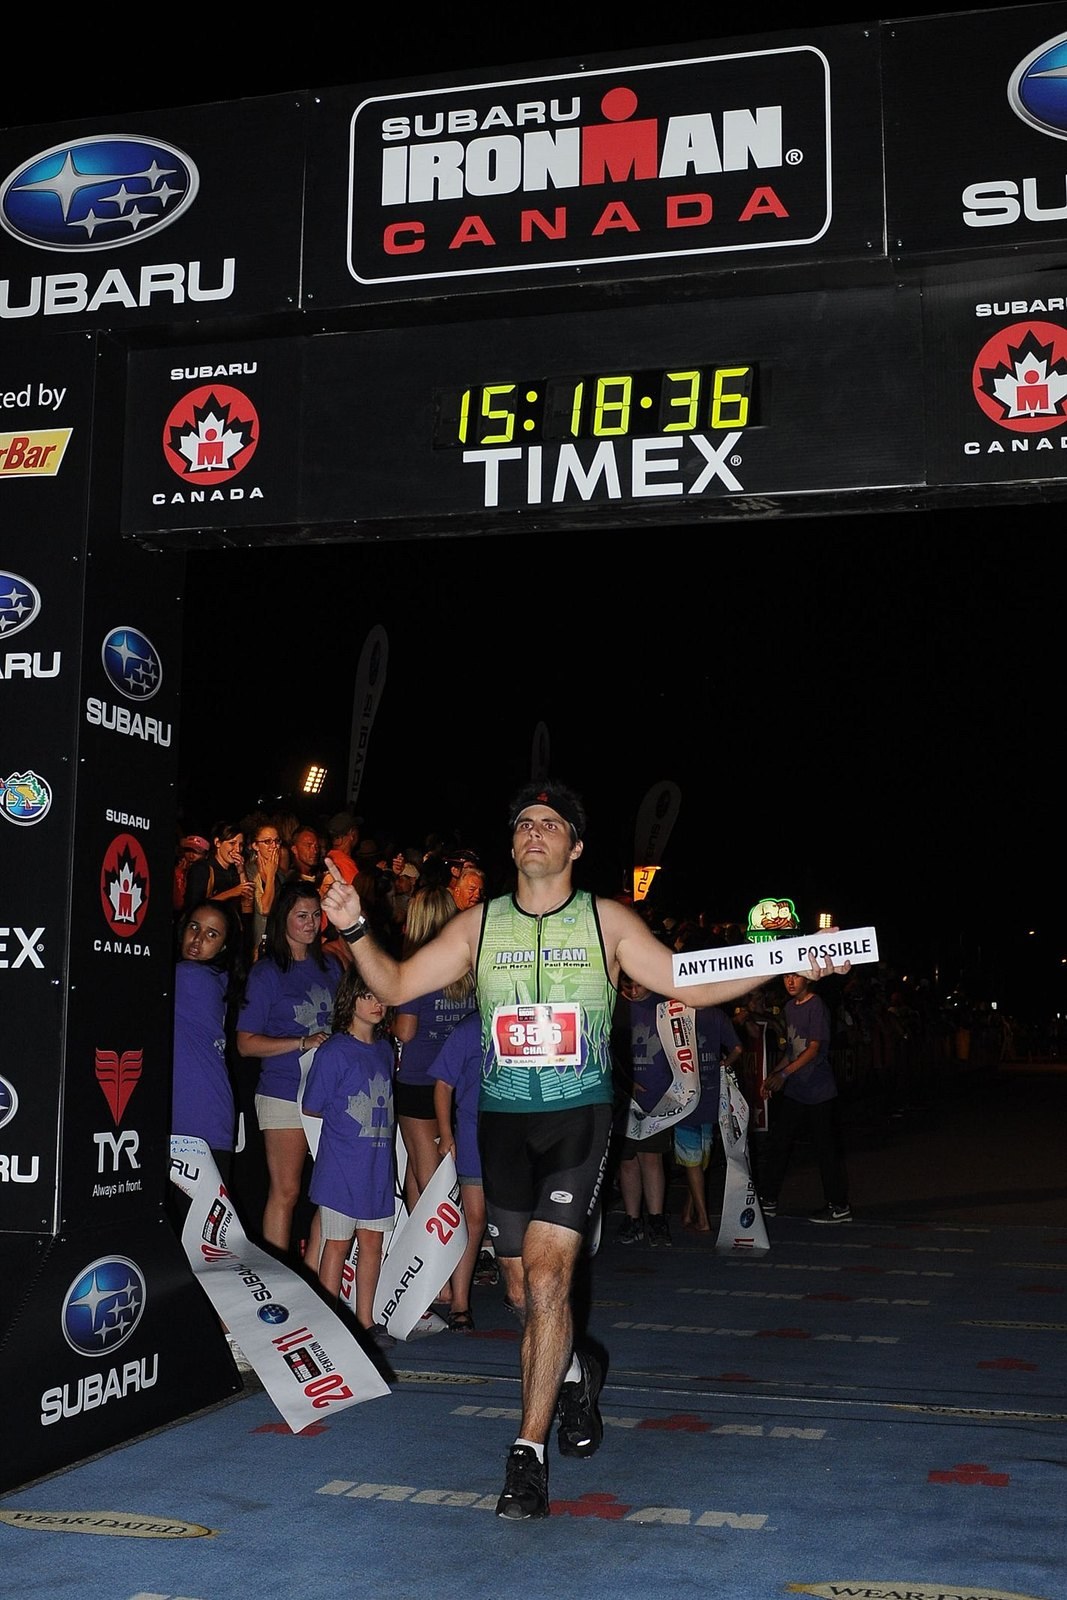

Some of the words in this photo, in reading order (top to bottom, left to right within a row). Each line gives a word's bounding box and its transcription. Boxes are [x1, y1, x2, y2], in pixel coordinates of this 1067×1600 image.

[381, 97, 580, 141] SUBARU
[381, 88, 783, 206] IRONMAN
[383, 187, 790, 255] CANADA
[0, 258, 235, 319] UBARU
[975, 298, 1067, 317] SUBAR
[170, 362, 257, 381] SUBARU
[38, 383, 67, 411] by
[463, 431, 744, 507] TIMEX
[152, 487, 264, 505] CANADA
[0, 651, 61, 680] RU
[86, 697, 171, 747] SUBARU
[105, 809, 150, 831] SUBARU
[94, 940, 150, 957] CANADA
[495, 950, 535, 964] IRON
[541, 948, 587, 962] TEAM
[678, 954, 754, 977] ANYTHING
[770, 951, 783, 965] IS
[798, 939, 871, 962] POSSIBLE
[677, 1048, 695, 1074] 20
[93, 1130, 141, 1173] TYR
[92, 1184, 117, 1198] Always
[118, 1181, 125, 1193] in
[219, 1210, 233, 1249] PENTICTON
[426, 1203, 461, 1246] 20
[309, 1341, 336, 1373] PENTICTON
[40, 1353, 159, 1426] SUBARU
[304, 1373, 354, 1409] 20
[13, 1513, 187, 1535] WEAR-DATED
